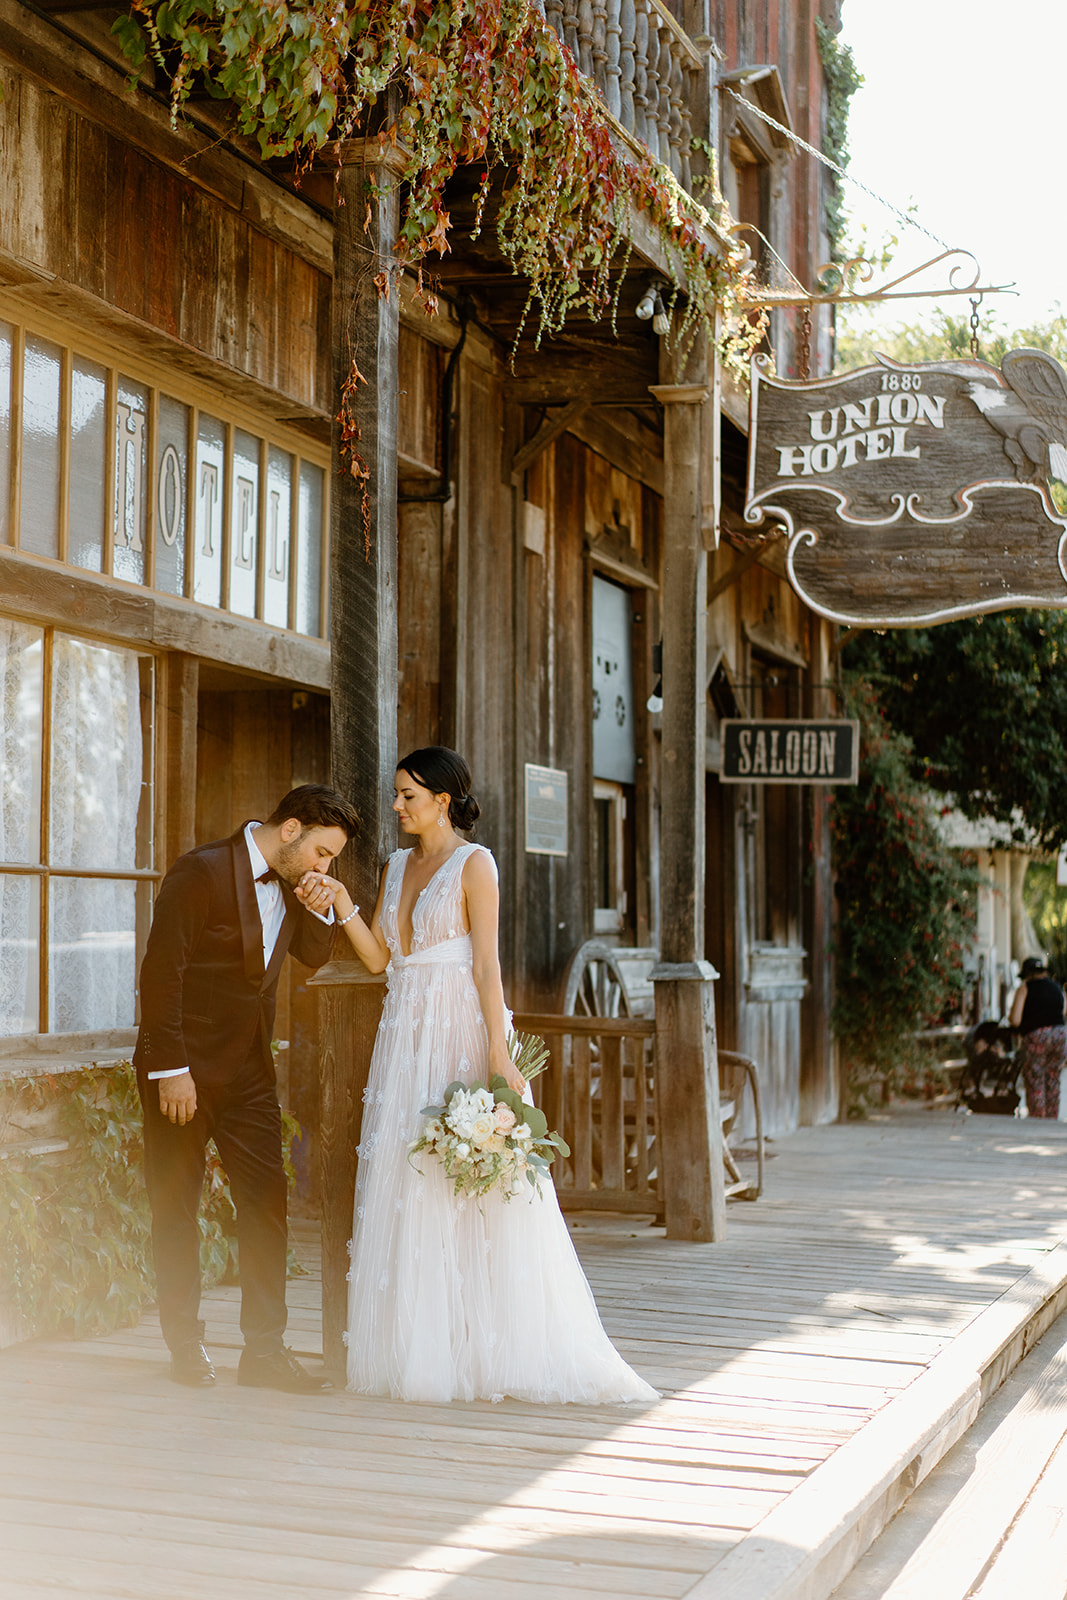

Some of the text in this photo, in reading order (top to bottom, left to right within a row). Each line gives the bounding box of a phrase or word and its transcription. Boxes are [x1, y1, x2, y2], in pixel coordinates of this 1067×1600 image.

[881, 374, 922, 391] 1880
[808, 394, 947, 441] UNION
[776, 427, 920, 476] HOTEL
[115, 403, 286, 581] HOTEL
[738, 730, 837, 775] SALOON
